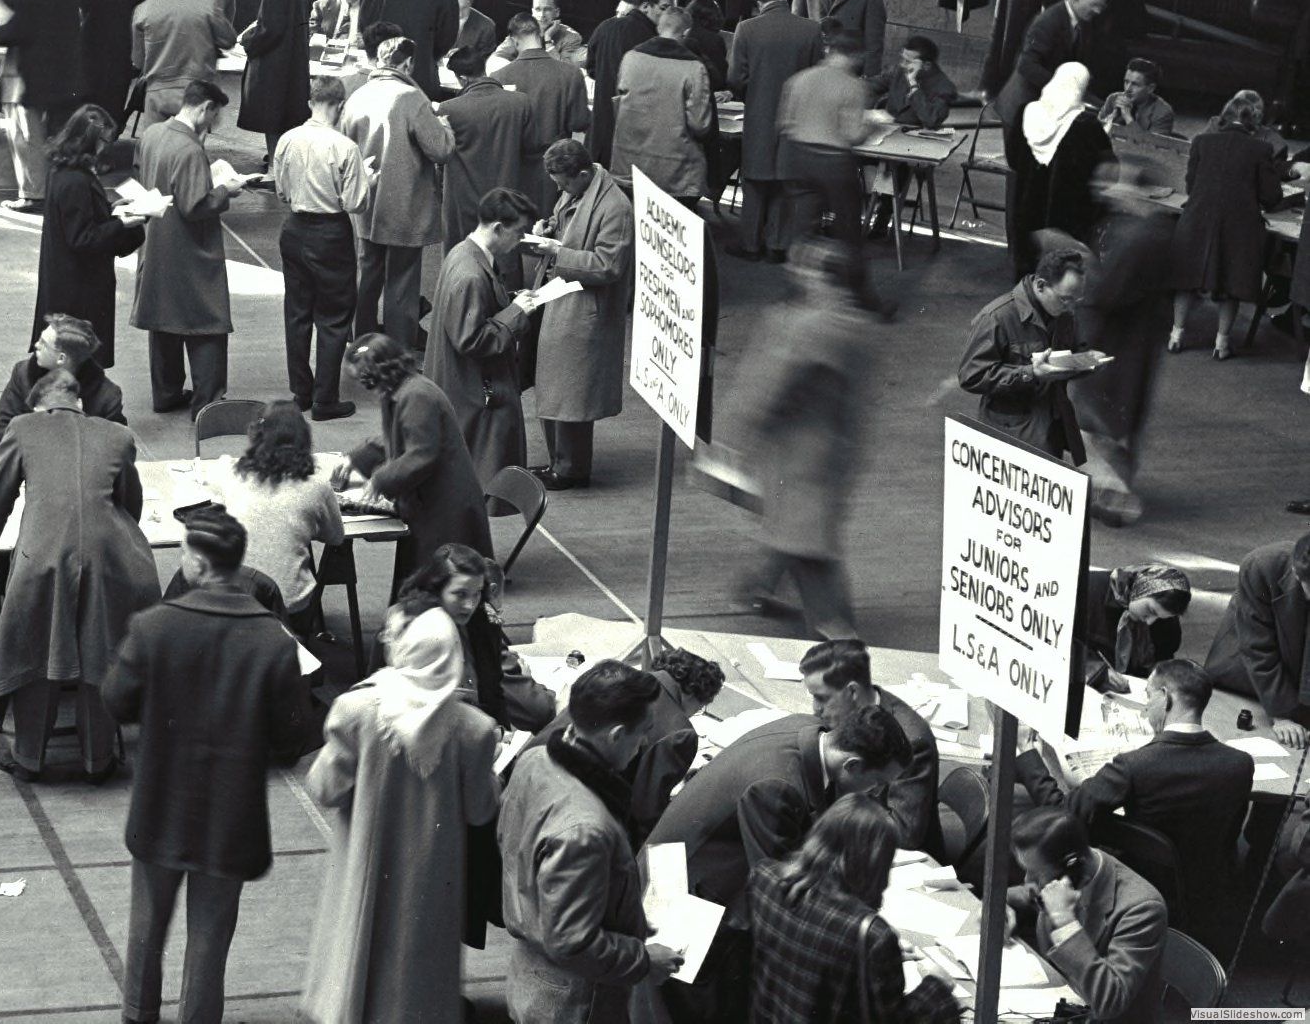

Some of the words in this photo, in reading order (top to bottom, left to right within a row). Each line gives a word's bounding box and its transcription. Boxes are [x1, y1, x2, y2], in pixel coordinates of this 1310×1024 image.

[646, 196, 687, 247] ACADEMIC
[640, 219, 696, 285] COUNSELORS
[640, 261, 681, 317] FRESHMEN
[640, 292, 693, 359] SOPHOMORES
[652, 336, 677, 374] ONLY
[669, 392, 690, 427] ONLY
[951, 439, 1074, 515] CONCENTRATION
[972, 486, 1052, 543] ADVISORS
[996, 529, 1021, 552] FOR
[960, 538, 1029, 592] JUNIORS
[1034, 580, 1059, 599] AND
[951, 566, 1013, 623] SENIORS
[1021, 604, 1063, 649] ONLY
[1009, 658, 1053, 703] ONLY
